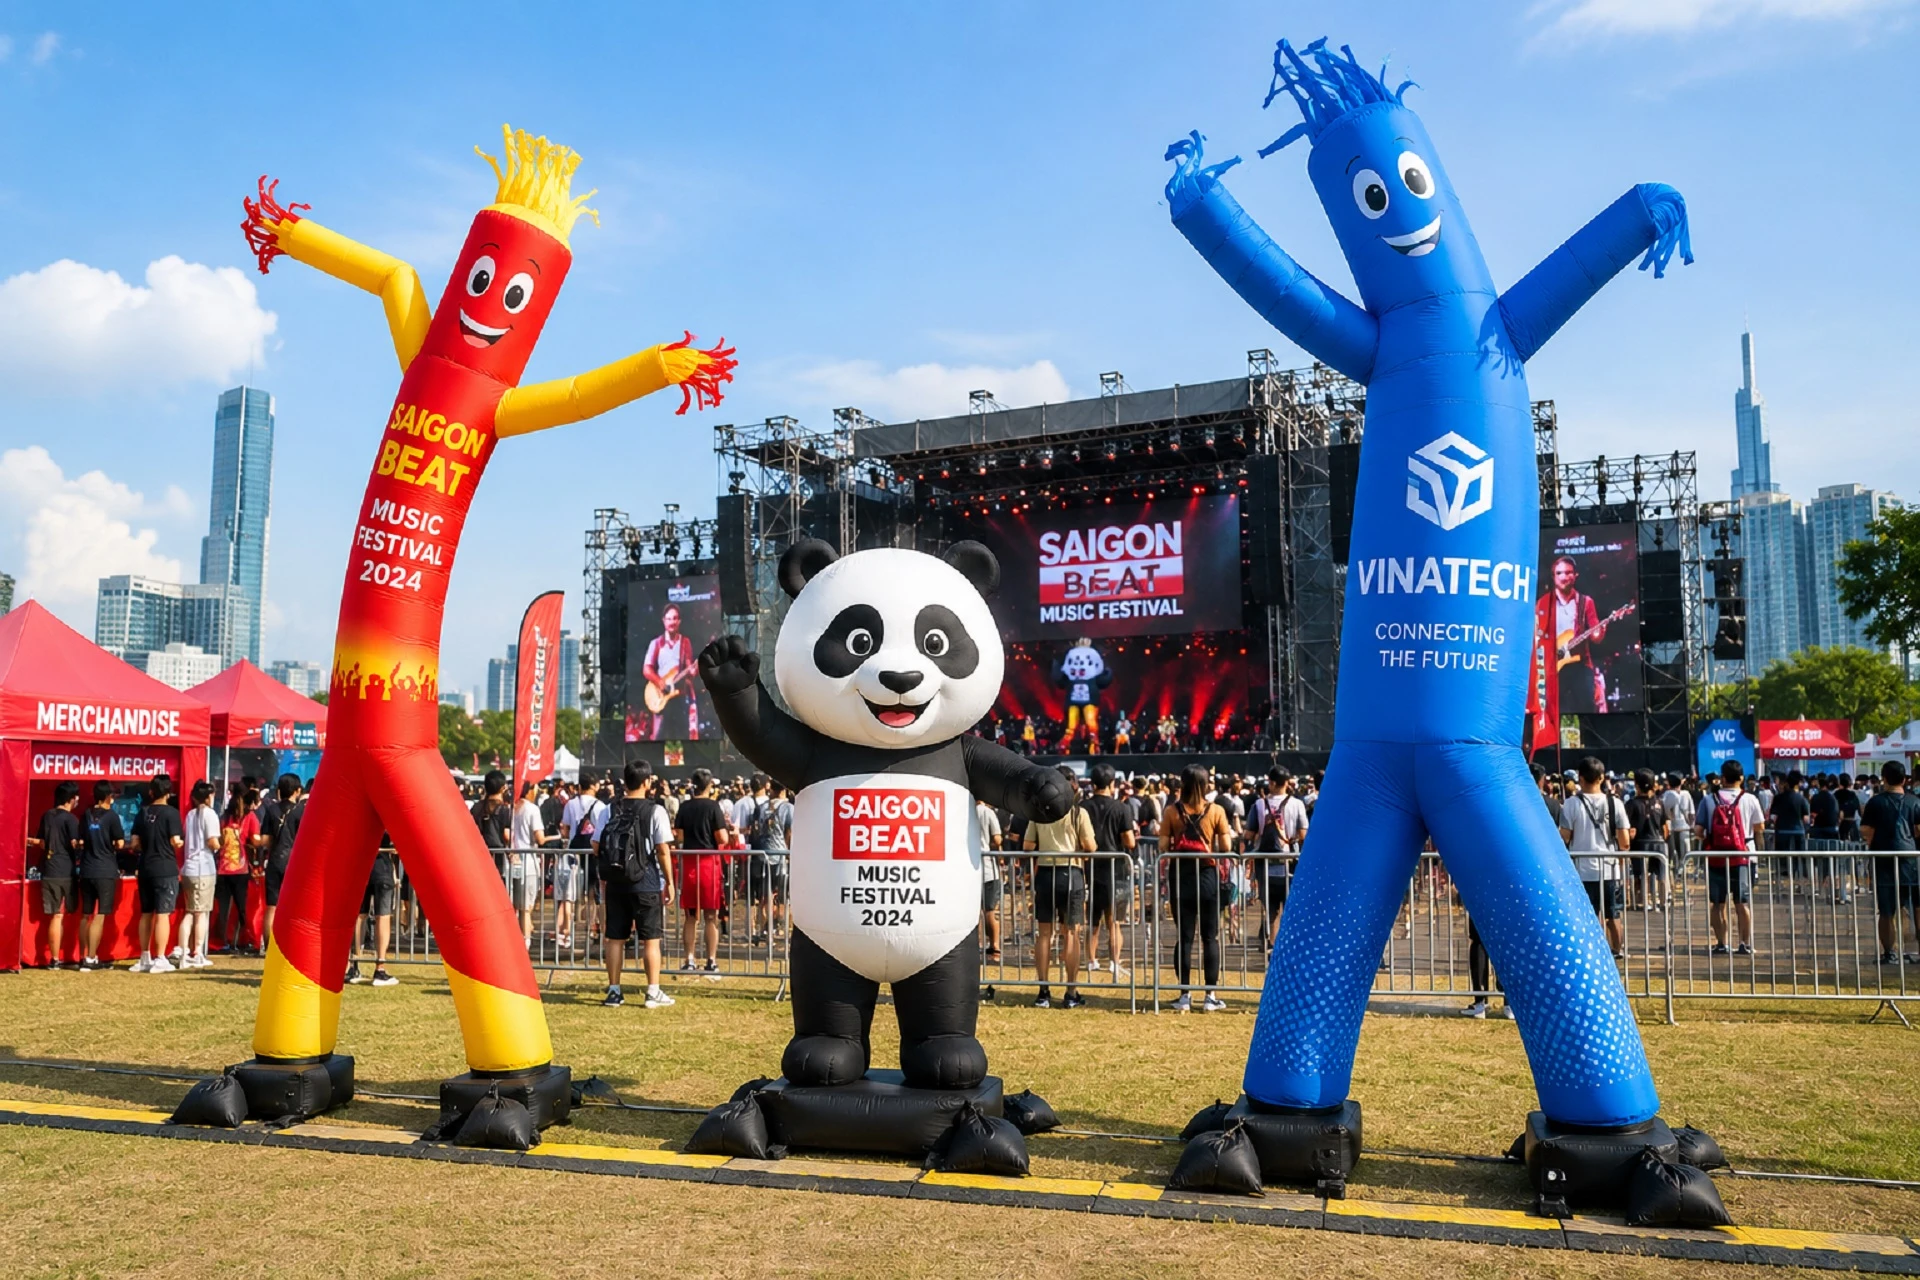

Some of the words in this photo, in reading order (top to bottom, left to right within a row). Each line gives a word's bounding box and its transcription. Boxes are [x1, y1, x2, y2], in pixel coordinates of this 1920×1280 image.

[391, 403, 487, 458] SAIGON
[377, 440, 470, 496] BEAT
[370, 498, 444, 535] MUSIC
[357, 526, 442, 566] FESTIVAL
[1039, 521, 1182, 565] SAIGON
[359, 560, 421, 592] 2024
[1064, 565, 1160, 598] BEAT
[1358, 557, 1530, 603] VINATECH
[1041, 604, 1094, 623] MUSIC
[1099, 599, 1183, 619] FESTIVAL
[1375, 623, 1505, 644] CONNECTING
[1379, 650, 1415, 667] THE
[1422, 651, 1500, 671] FUTURE
[37, 702, 180, 737] MERCHANDISE
[1712, 729, 1736, 743] WC
[33, 754, 105, 775] OFFICIAL
[839, 795, 941, 820] SAIGON
[849, 825, 930, 853] BEAT
[857, 865, 921, 883] MUSIC
[840, 886, 935, 905] FESTIVAL
[861, 909, 914, 926] 2024
